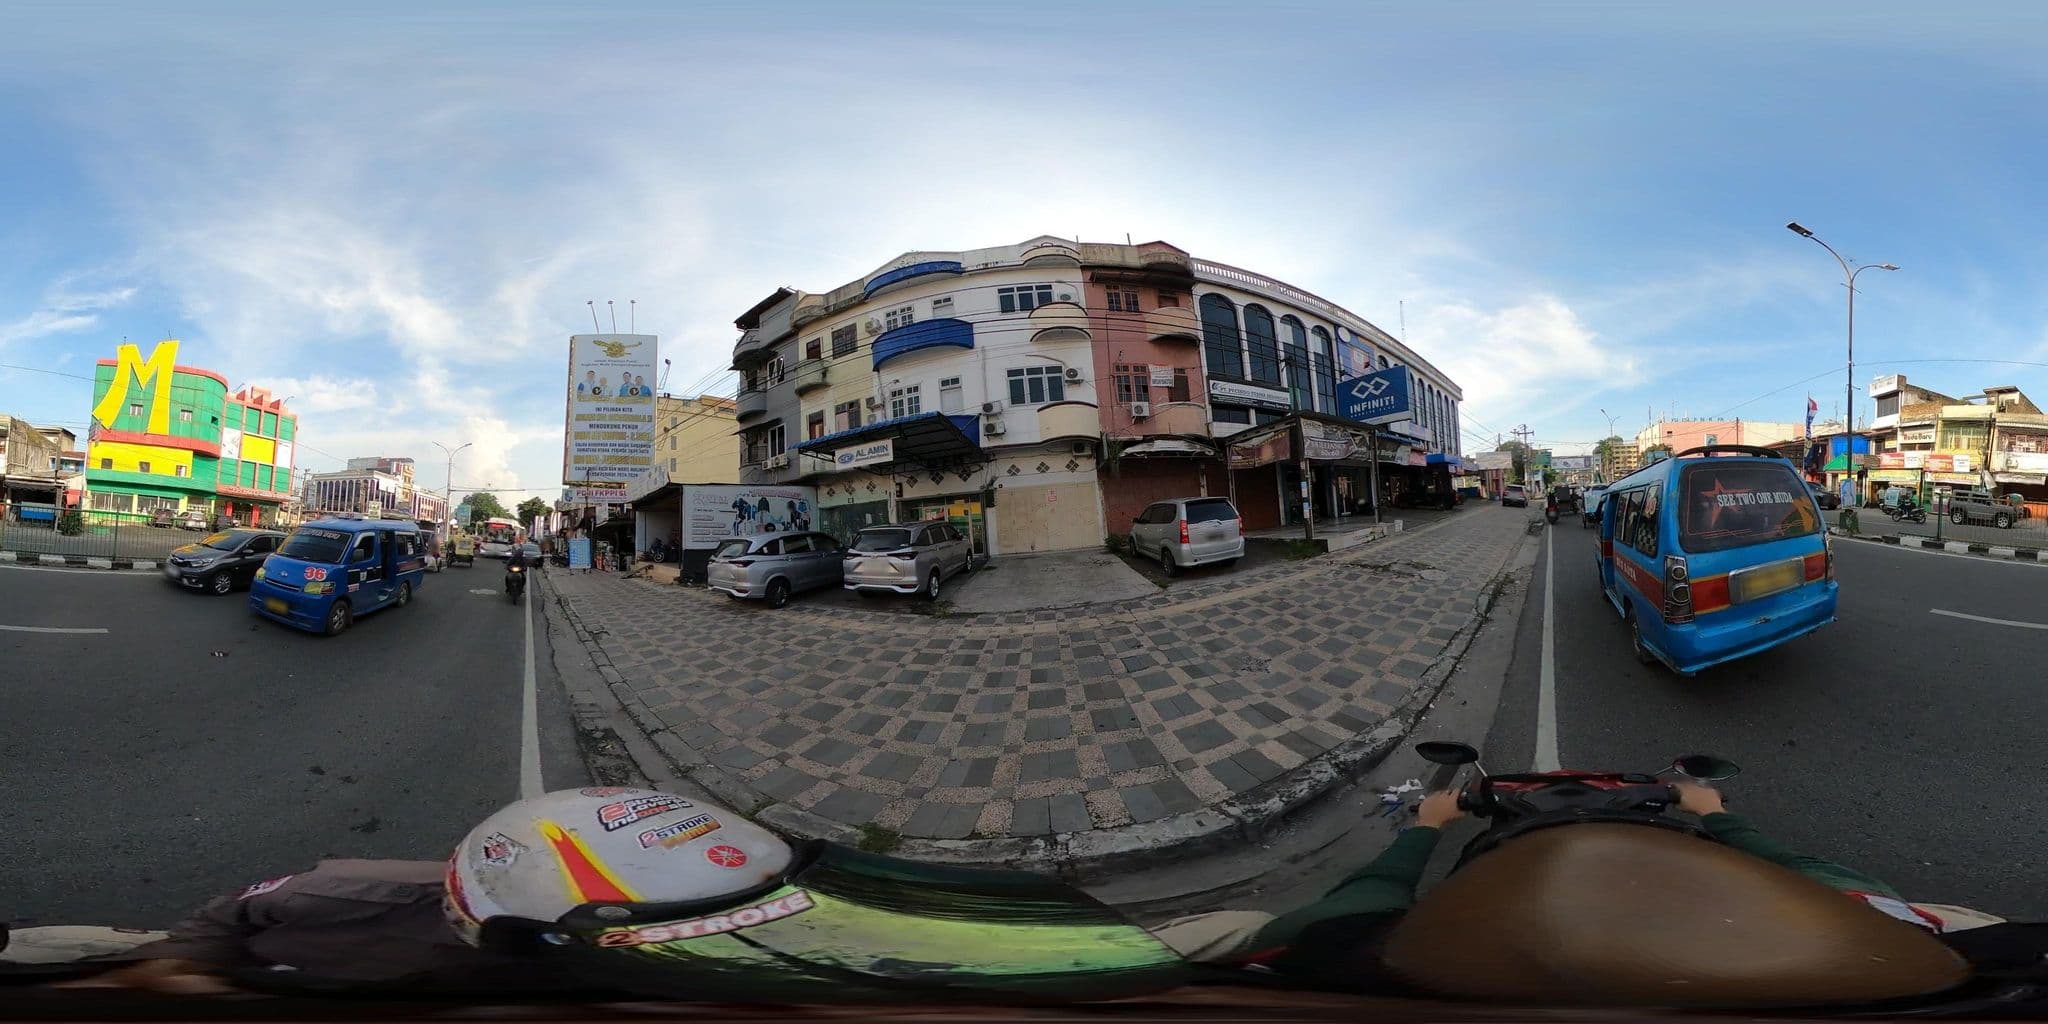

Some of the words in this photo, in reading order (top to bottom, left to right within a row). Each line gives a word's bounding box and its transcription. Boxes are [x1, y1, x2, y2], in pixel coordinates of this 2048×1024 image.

[92, 339, 180, 435] M
[1350, 395, 1395, 414] INFINITI
[1717, 494, 1737, 507] SEE
[1736, 493, 1756, 506] TWO
[1756, 492, 1774, 504] ONE
[304, 566, 327, 581] 36
